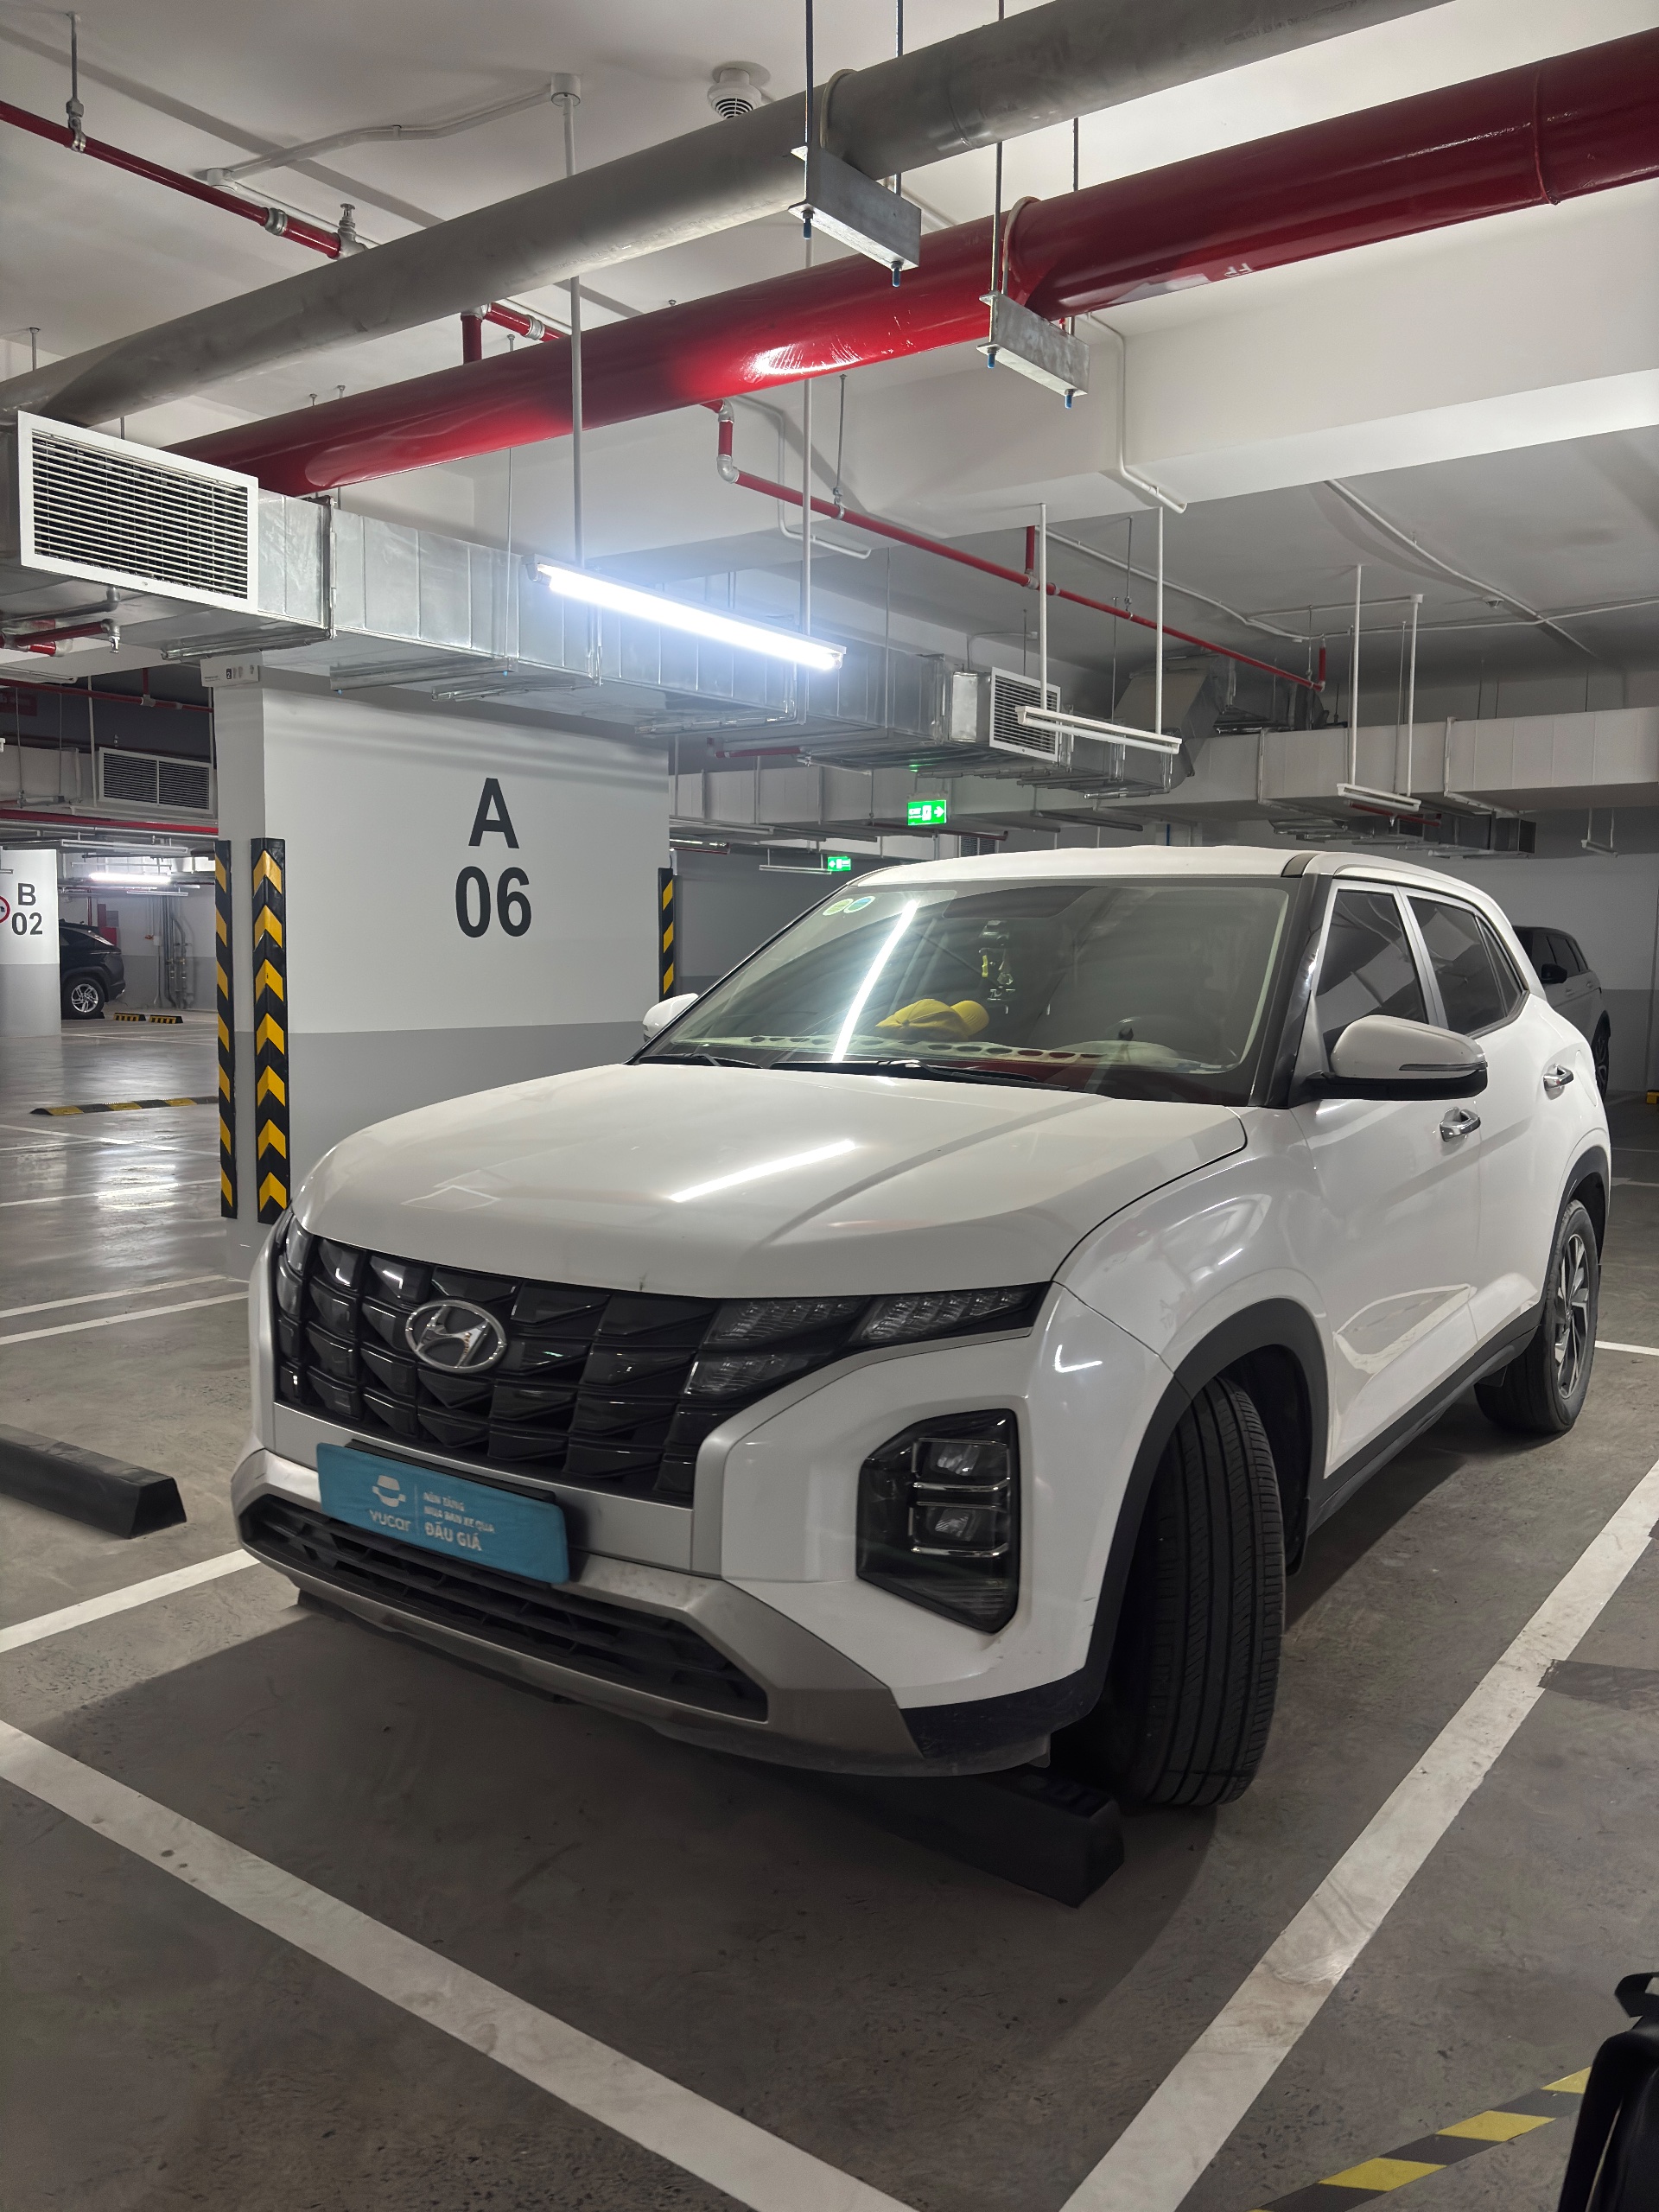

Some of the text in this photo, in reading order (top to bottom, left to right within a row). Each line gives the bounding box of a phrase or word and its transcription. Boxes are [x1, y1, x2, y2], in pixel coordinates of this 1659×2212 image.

[468, 777, 520, 849] A
[18, 882, 36, 906] B
[455, 866, 531, 938] 06
[11, 912, 43, 936] 02
[456, 1532, 483, 1552] GIÁ
